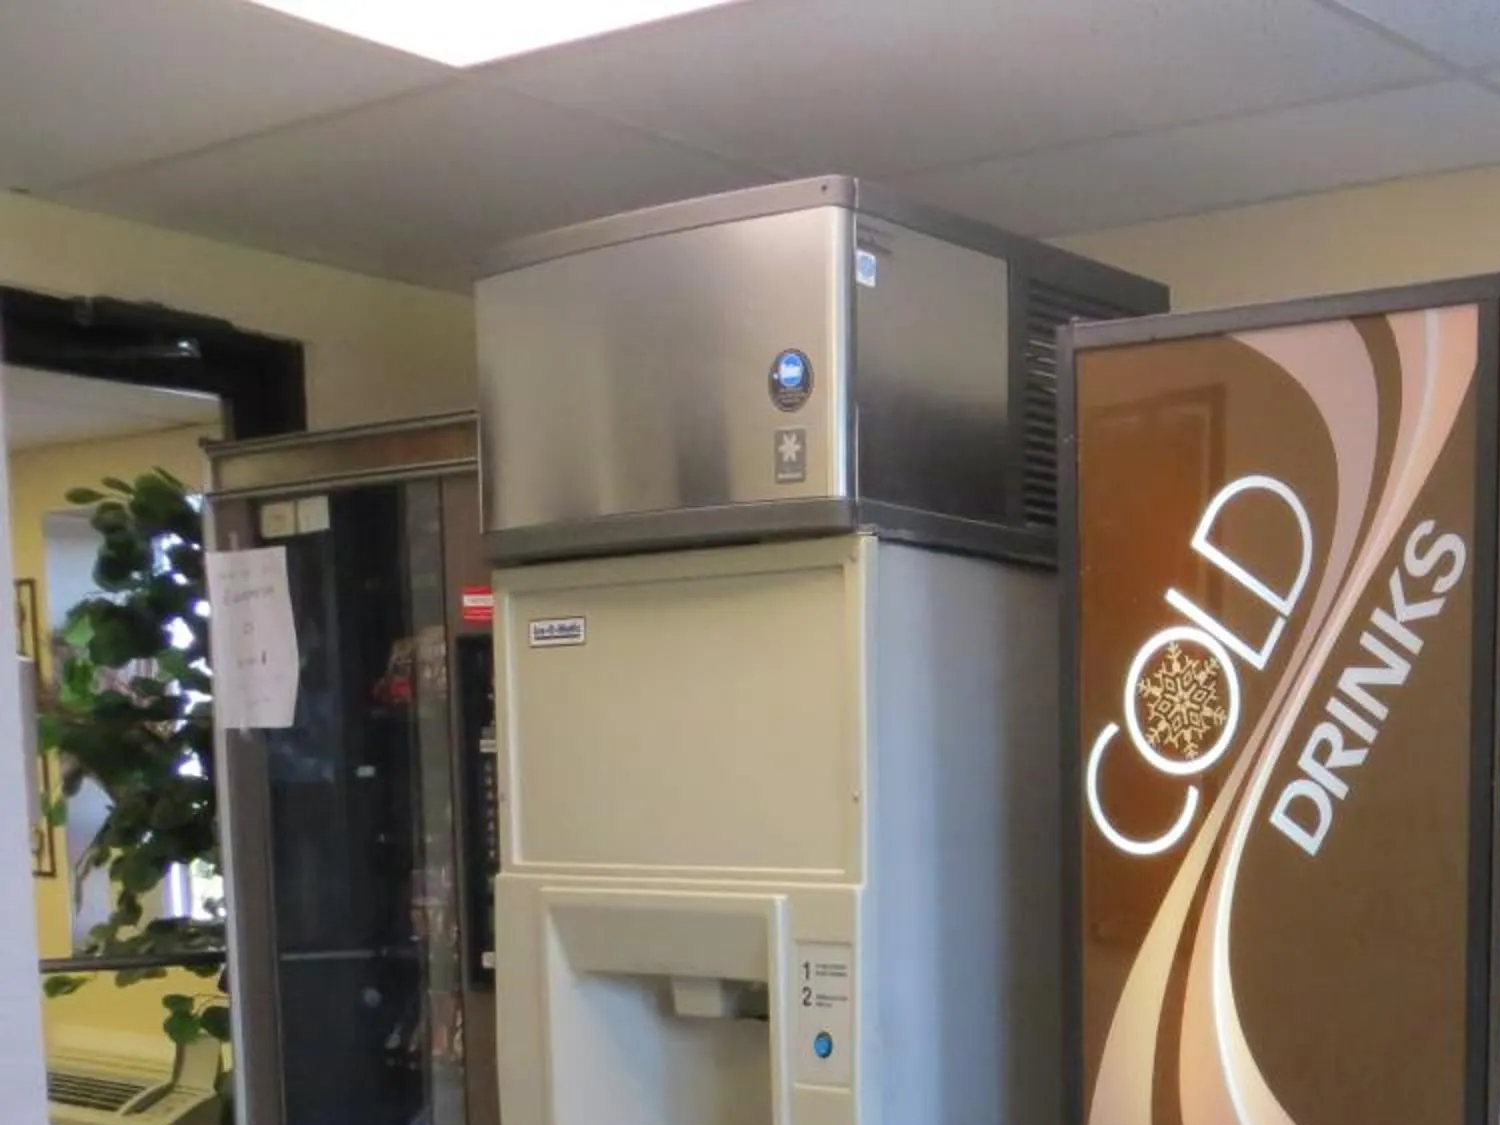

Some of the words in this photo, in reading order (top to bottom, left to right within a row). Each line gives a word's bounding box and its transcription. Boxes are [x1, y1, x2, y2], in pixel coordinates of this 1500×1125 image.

[1087, 474, 1313, 855] COLD
[1269, 519, 1467, 857] DRINKS
[801, 985, 813, 1008] 2
[802, 960, 811, 981] 1
